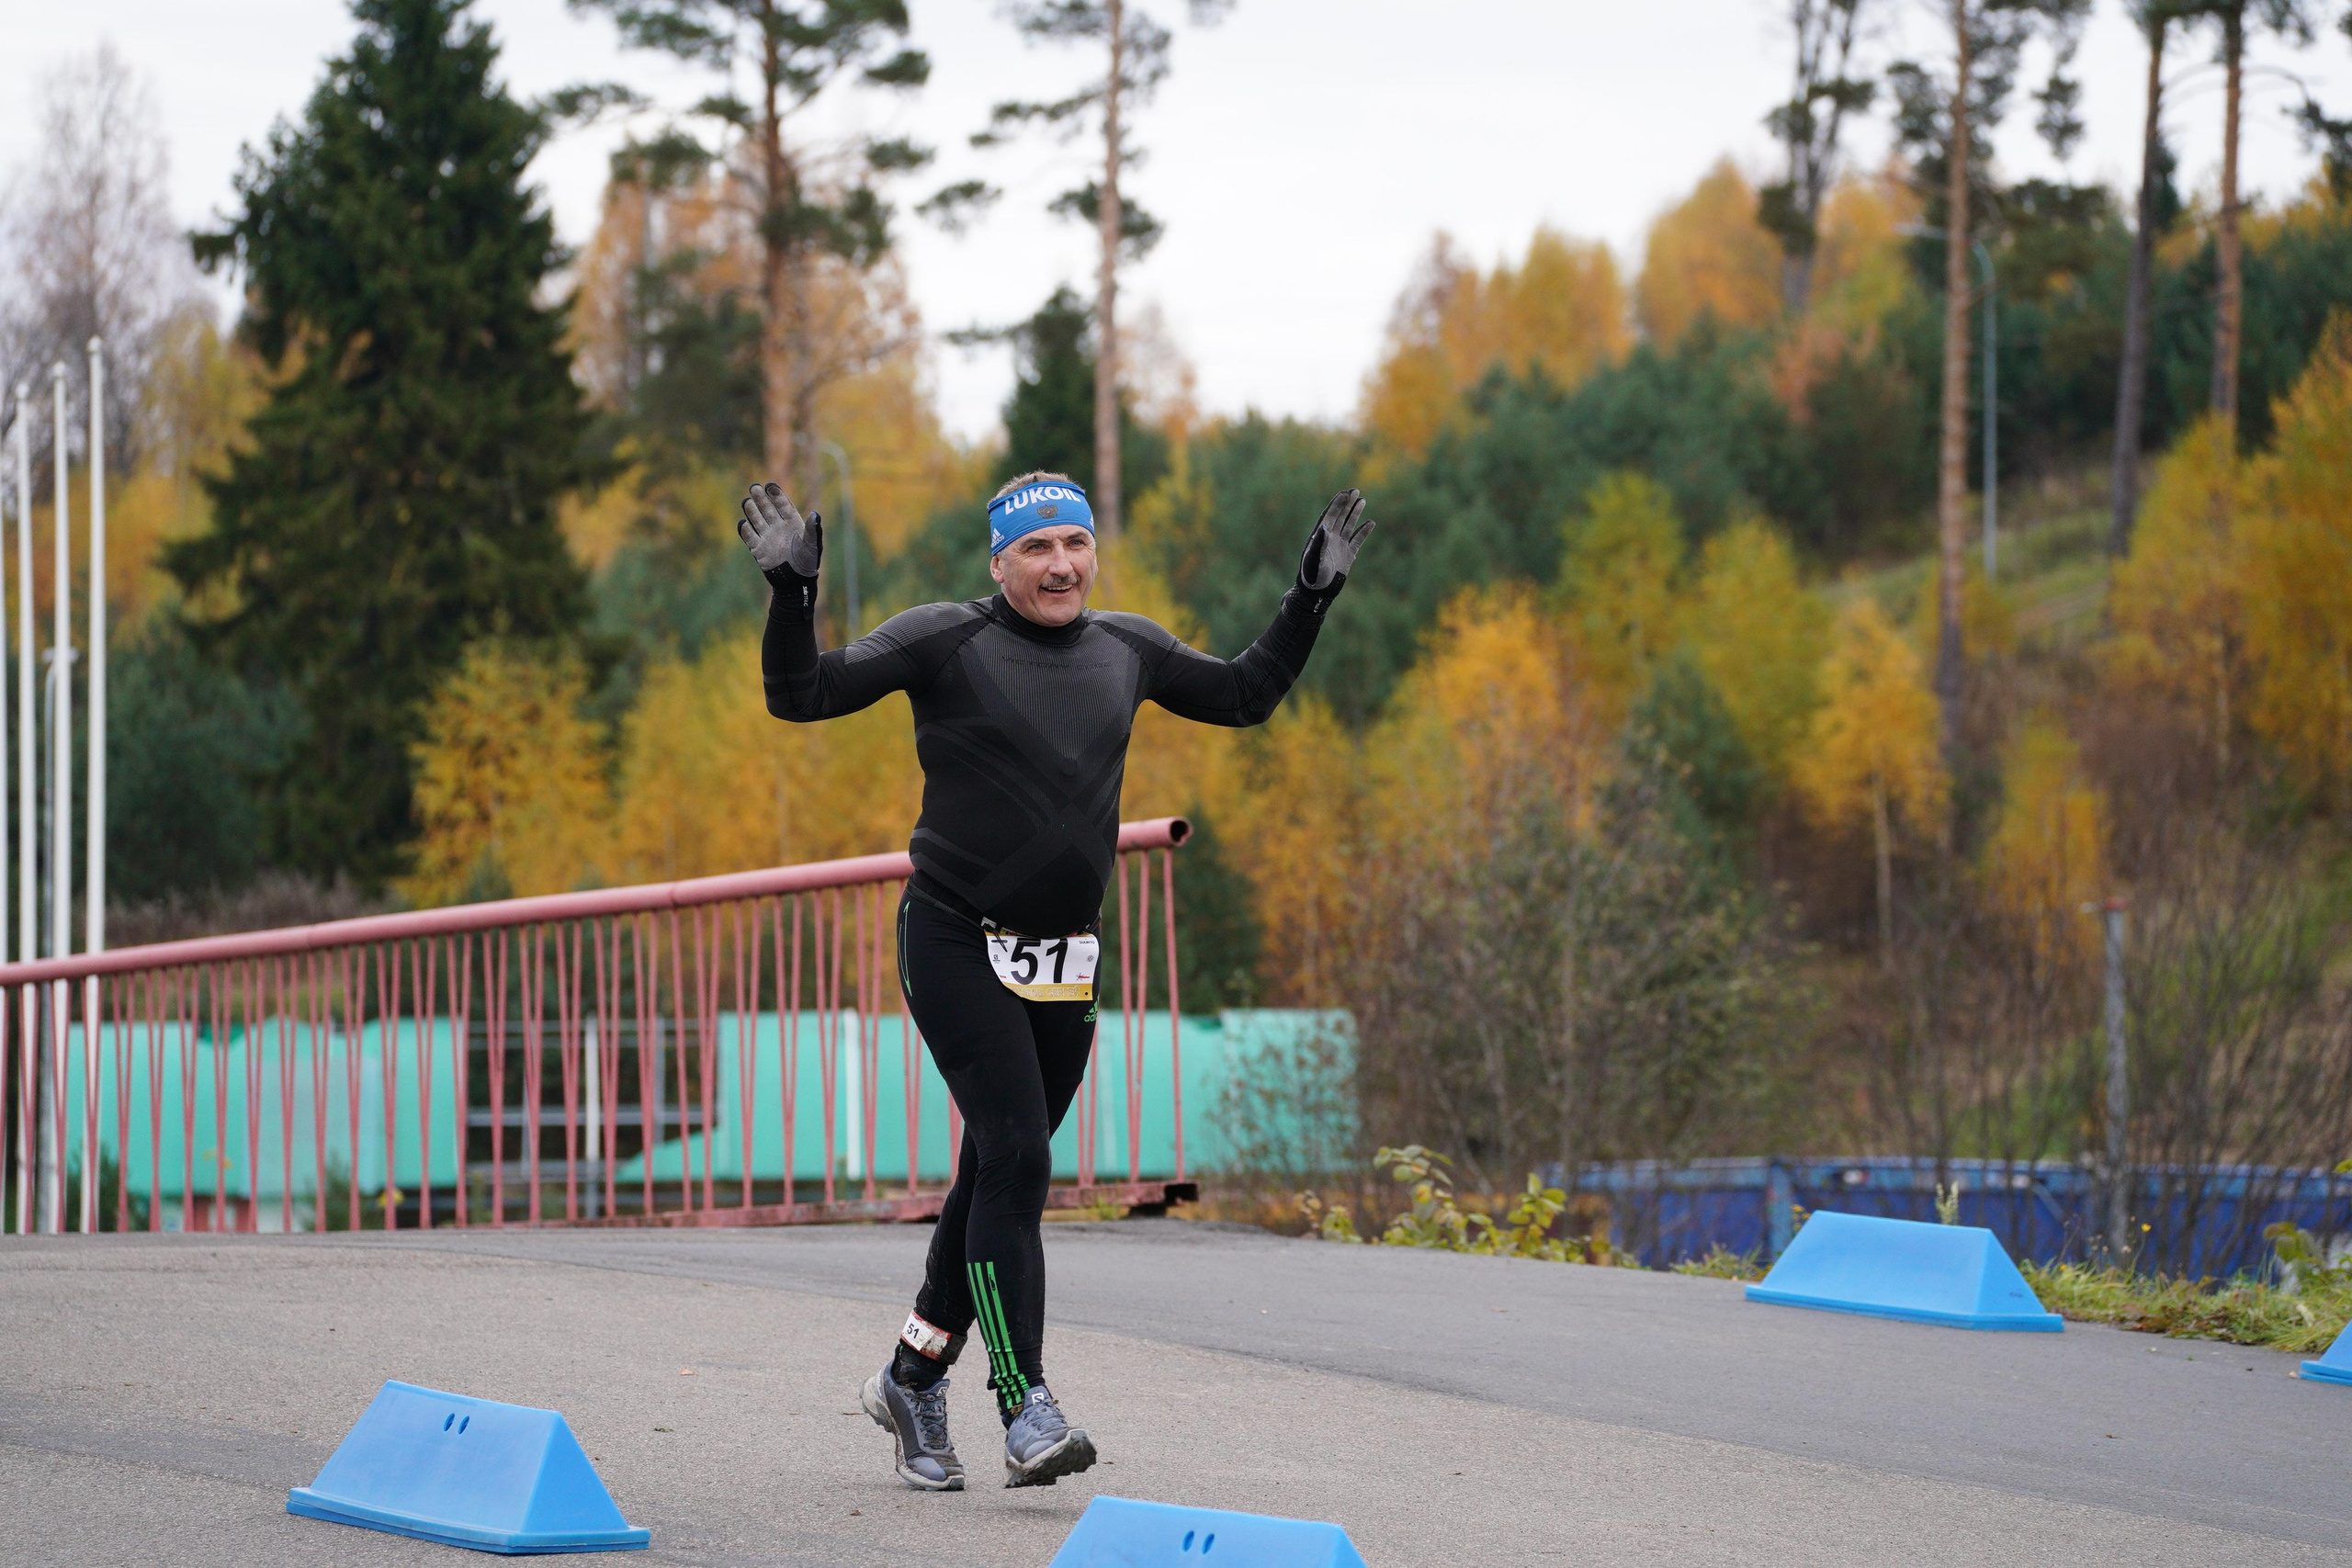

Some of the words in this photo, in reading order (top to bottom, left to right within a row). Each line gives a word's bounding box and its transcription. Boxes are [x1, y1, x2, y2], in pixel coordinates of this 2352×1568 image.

[1004, 486, 1081, 515] LUKOIL
[1010, 937, 1069, 986] 51
[907, 1323, 920, 1339] 51
